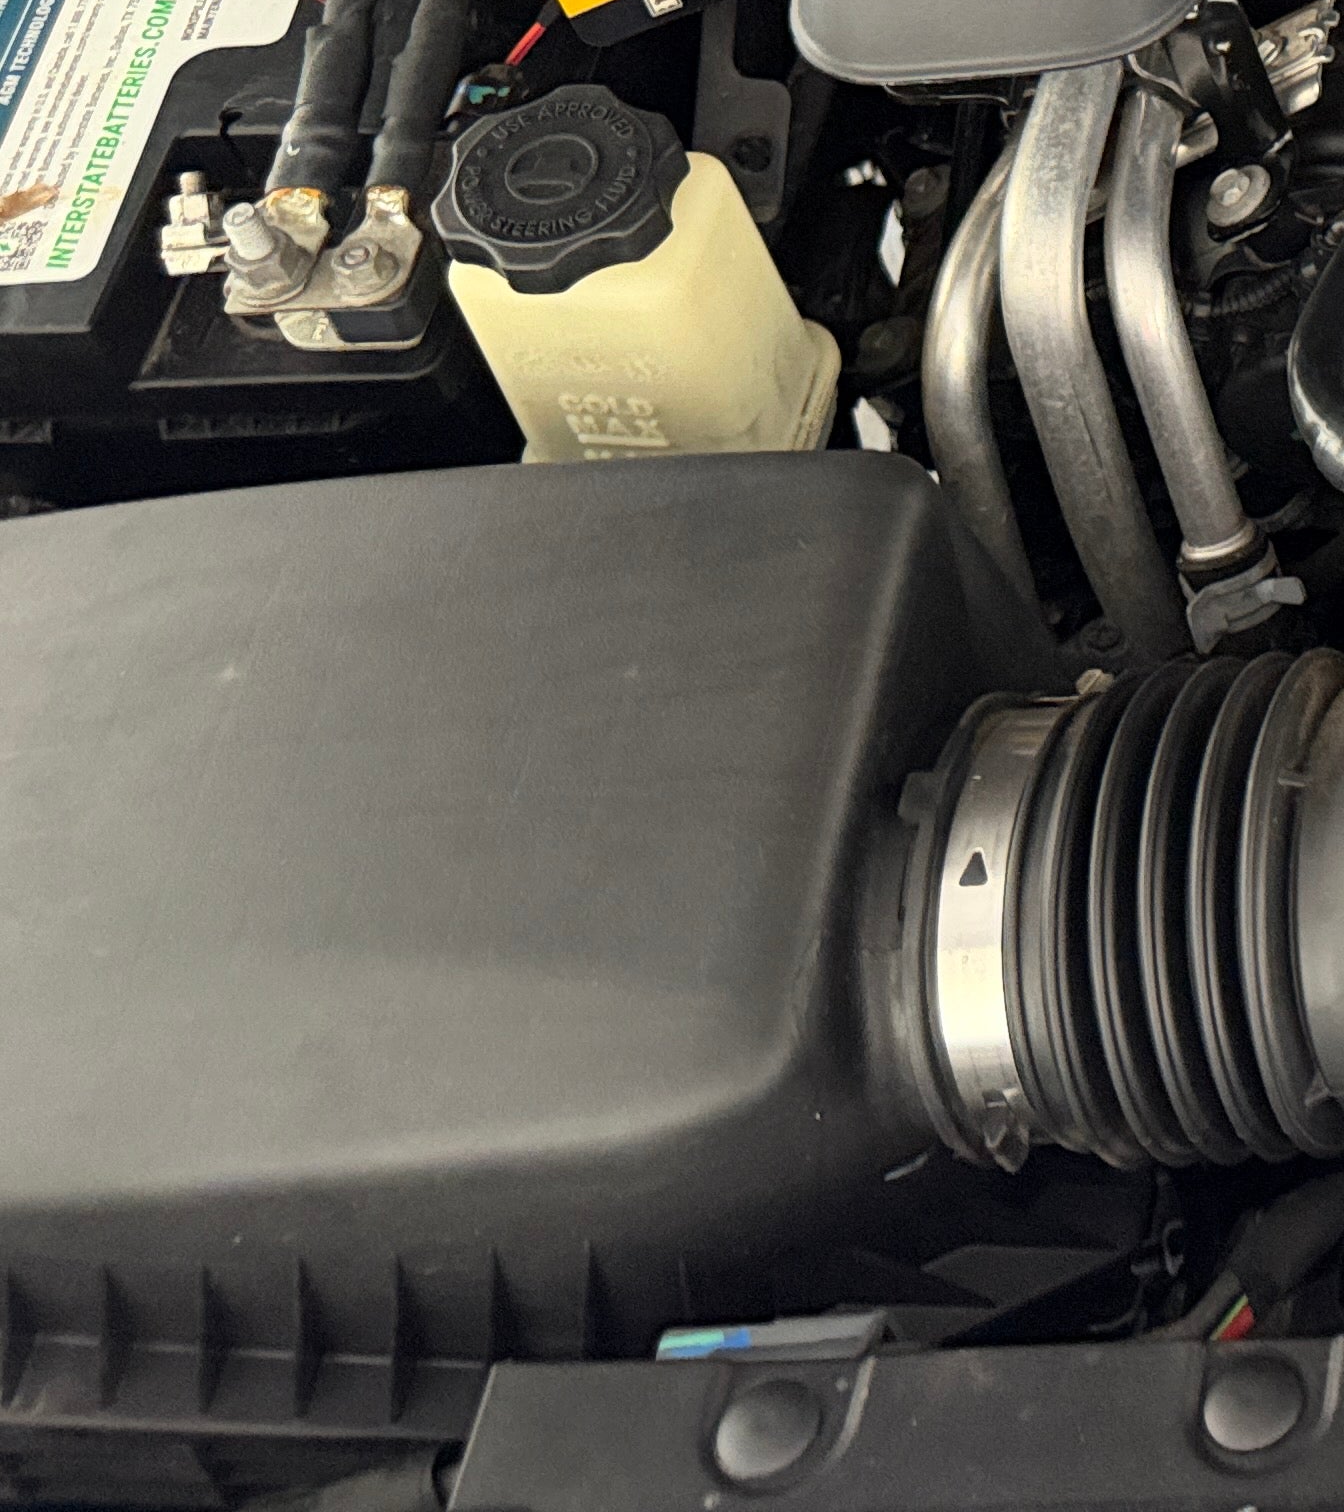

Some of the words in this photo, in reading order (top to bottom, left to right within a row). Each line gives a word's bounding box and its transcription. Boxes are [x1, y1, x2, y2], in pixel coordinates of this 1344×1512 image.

[47, 0, 177, 270] INTERSTATEBATTERIES.COM
[491, 111, 534, 141] USE
[537, 102, 636, 139] APPROVED
[463, 164, 492, 224] POWER
[490, 208, 593, 239] STEERING
[595, 166, 637, 215] FLUID
[558, 393, 654, 416] COLD
[565, 414, 666, 438] MAX
